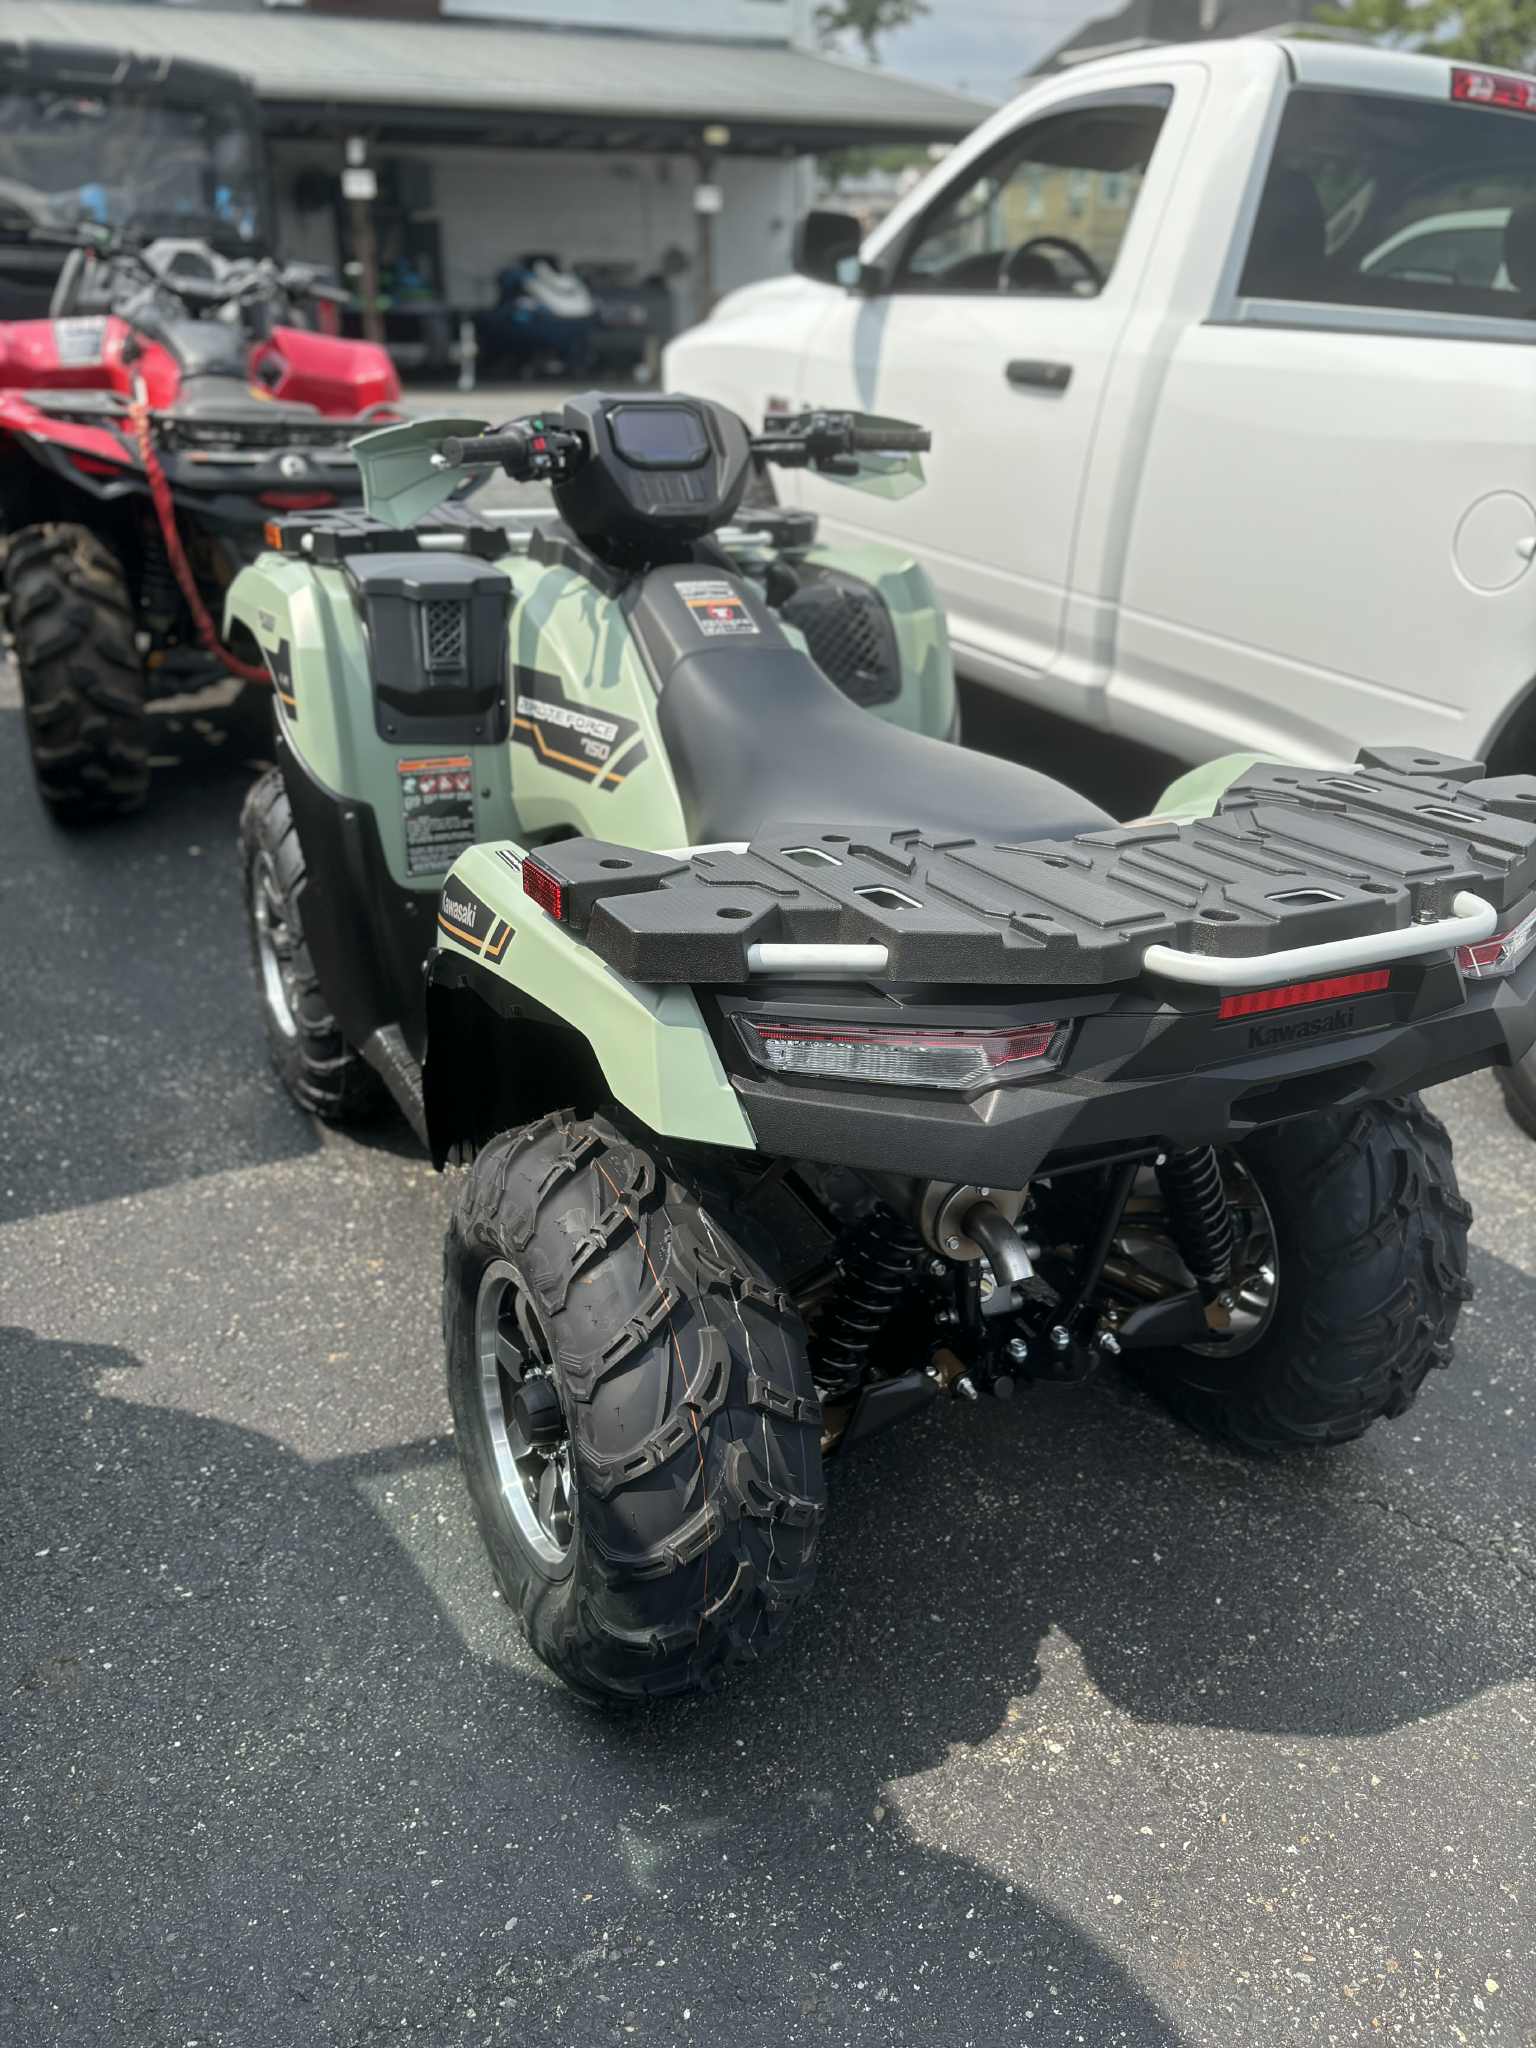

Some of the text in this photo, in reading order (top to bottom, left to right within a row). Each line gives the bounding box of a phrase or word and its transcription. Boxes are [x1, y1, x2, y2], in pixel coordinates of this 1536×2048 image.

[565, 705, 619, 742] FORCE
[580, 737, 611, 760] 750
[441, 889, 477, 928] Kawasaki
[1248, 1005, 1356, 1049] Kawasaki
